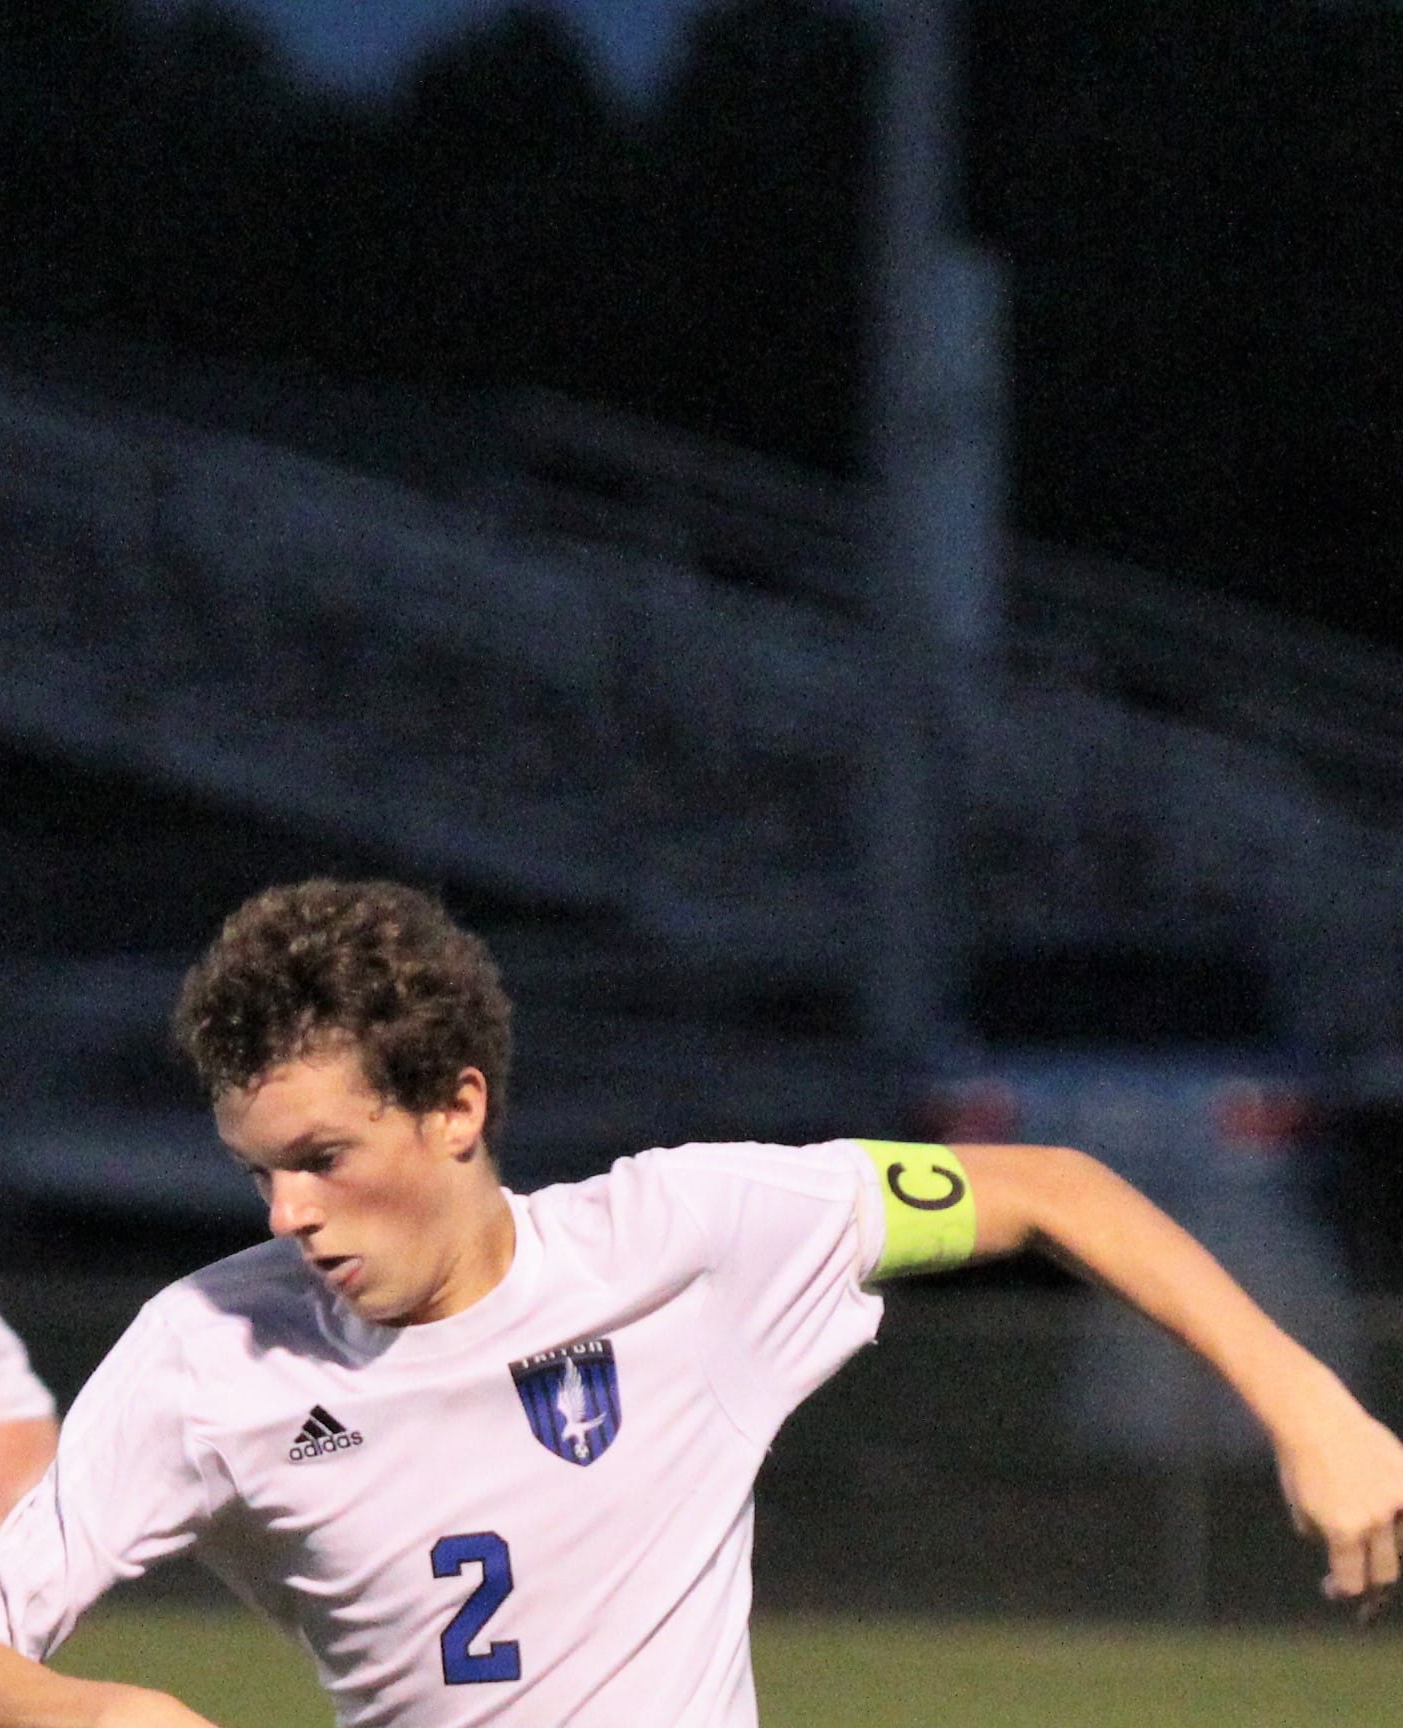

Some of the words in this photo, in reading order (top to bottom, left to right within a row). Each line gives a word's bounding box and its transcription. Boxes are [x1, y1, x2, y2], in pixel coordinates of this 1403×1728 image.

[887, 1162, 965, 1211] C
[289, 1431, 363, 1461] adidas
[430, 1530, 521, 1686] 2
